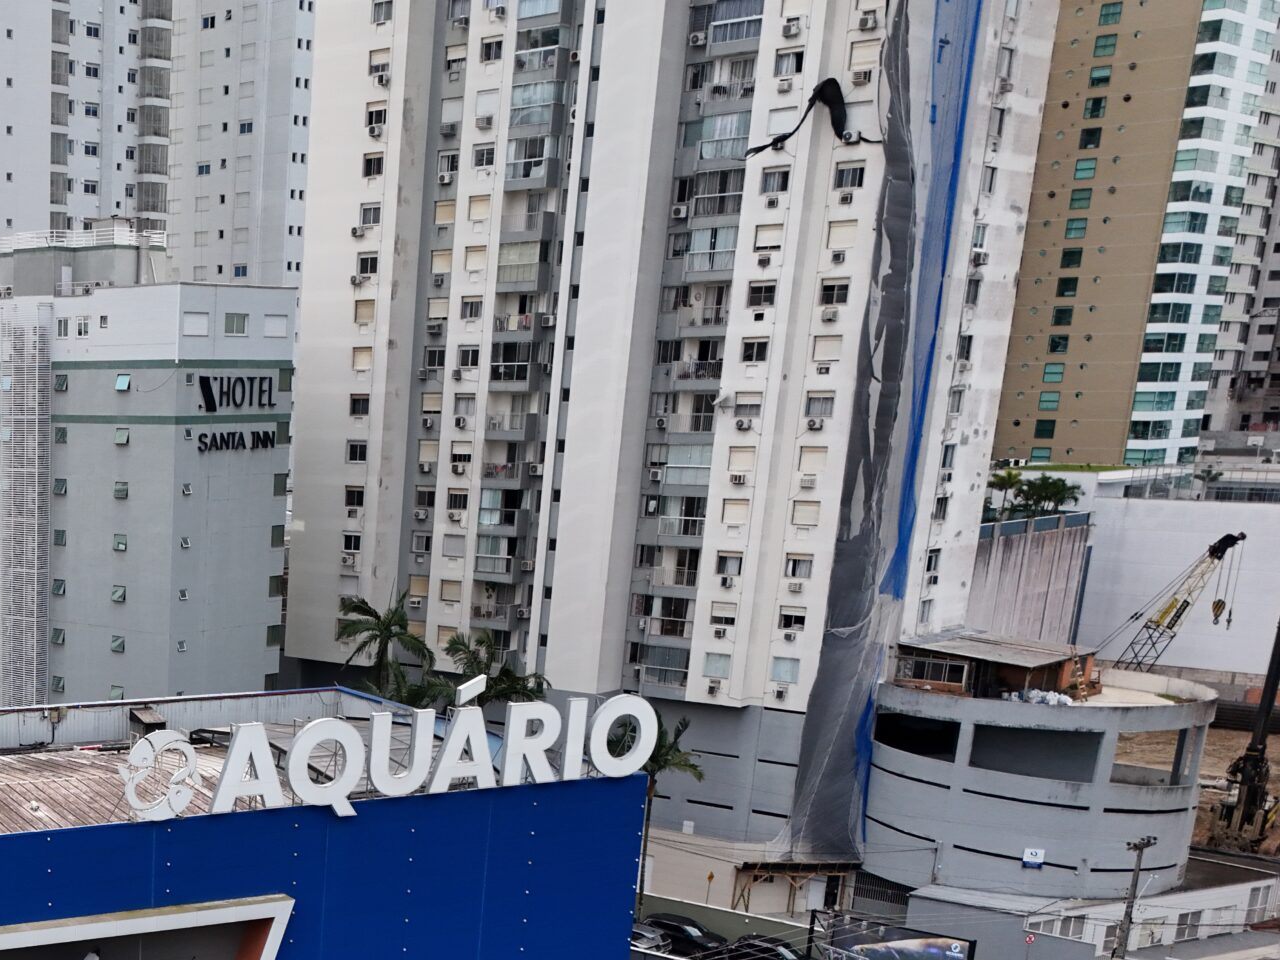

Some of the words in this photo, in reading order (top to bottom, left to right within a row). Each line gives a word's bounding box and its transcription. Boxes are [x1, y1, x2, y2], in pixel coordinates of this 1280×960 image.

[219, 376, 277, 408] HOTEL
[198, 431, 246, 452] SANTA
[250, 430, 276, 450] INN
[210, 674, 659, 817] AQUÁRIO
